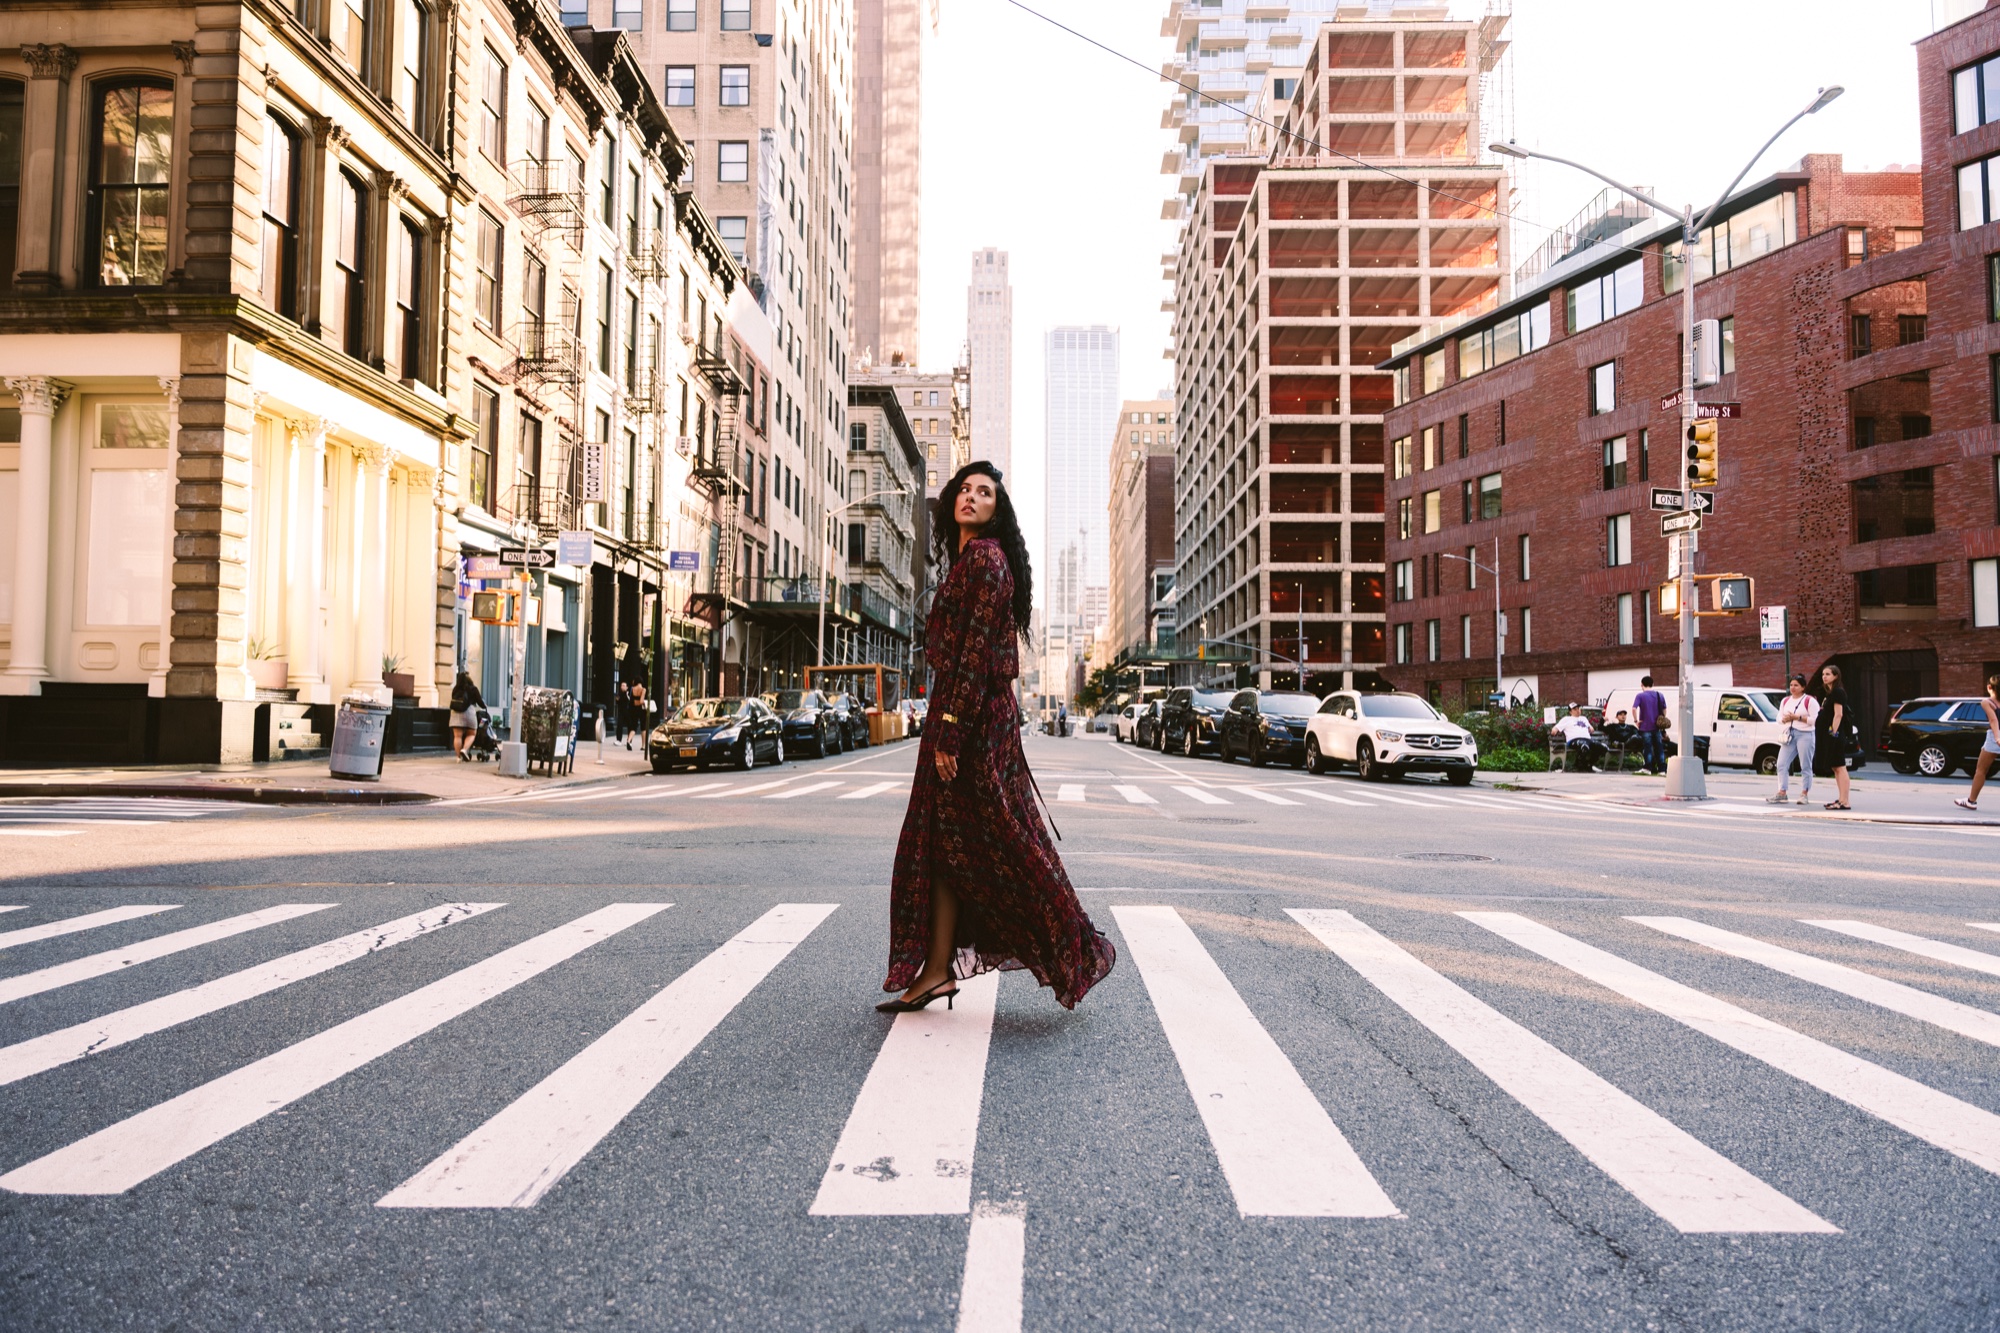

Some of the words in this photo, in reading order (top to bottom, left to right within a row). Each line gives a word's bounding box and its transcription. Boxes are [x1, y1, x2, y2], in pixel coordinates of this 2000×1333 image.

[1661, 395, 1676, 410] Church
[1677, 392, 1683, 404] St
[1697, 406, 1719, 417] White
[1722, 406, 1731, 417] St
[587, 446, 600, 498] BURLESQUE
[1660, 495, 1678, 505] ONE
[1666, 519, 1678, 529] ONE
[1682, 515, 1695, 525] WAY
[507, 553, 524, 561] ONE
[531, 554, 548, 562] WAY
